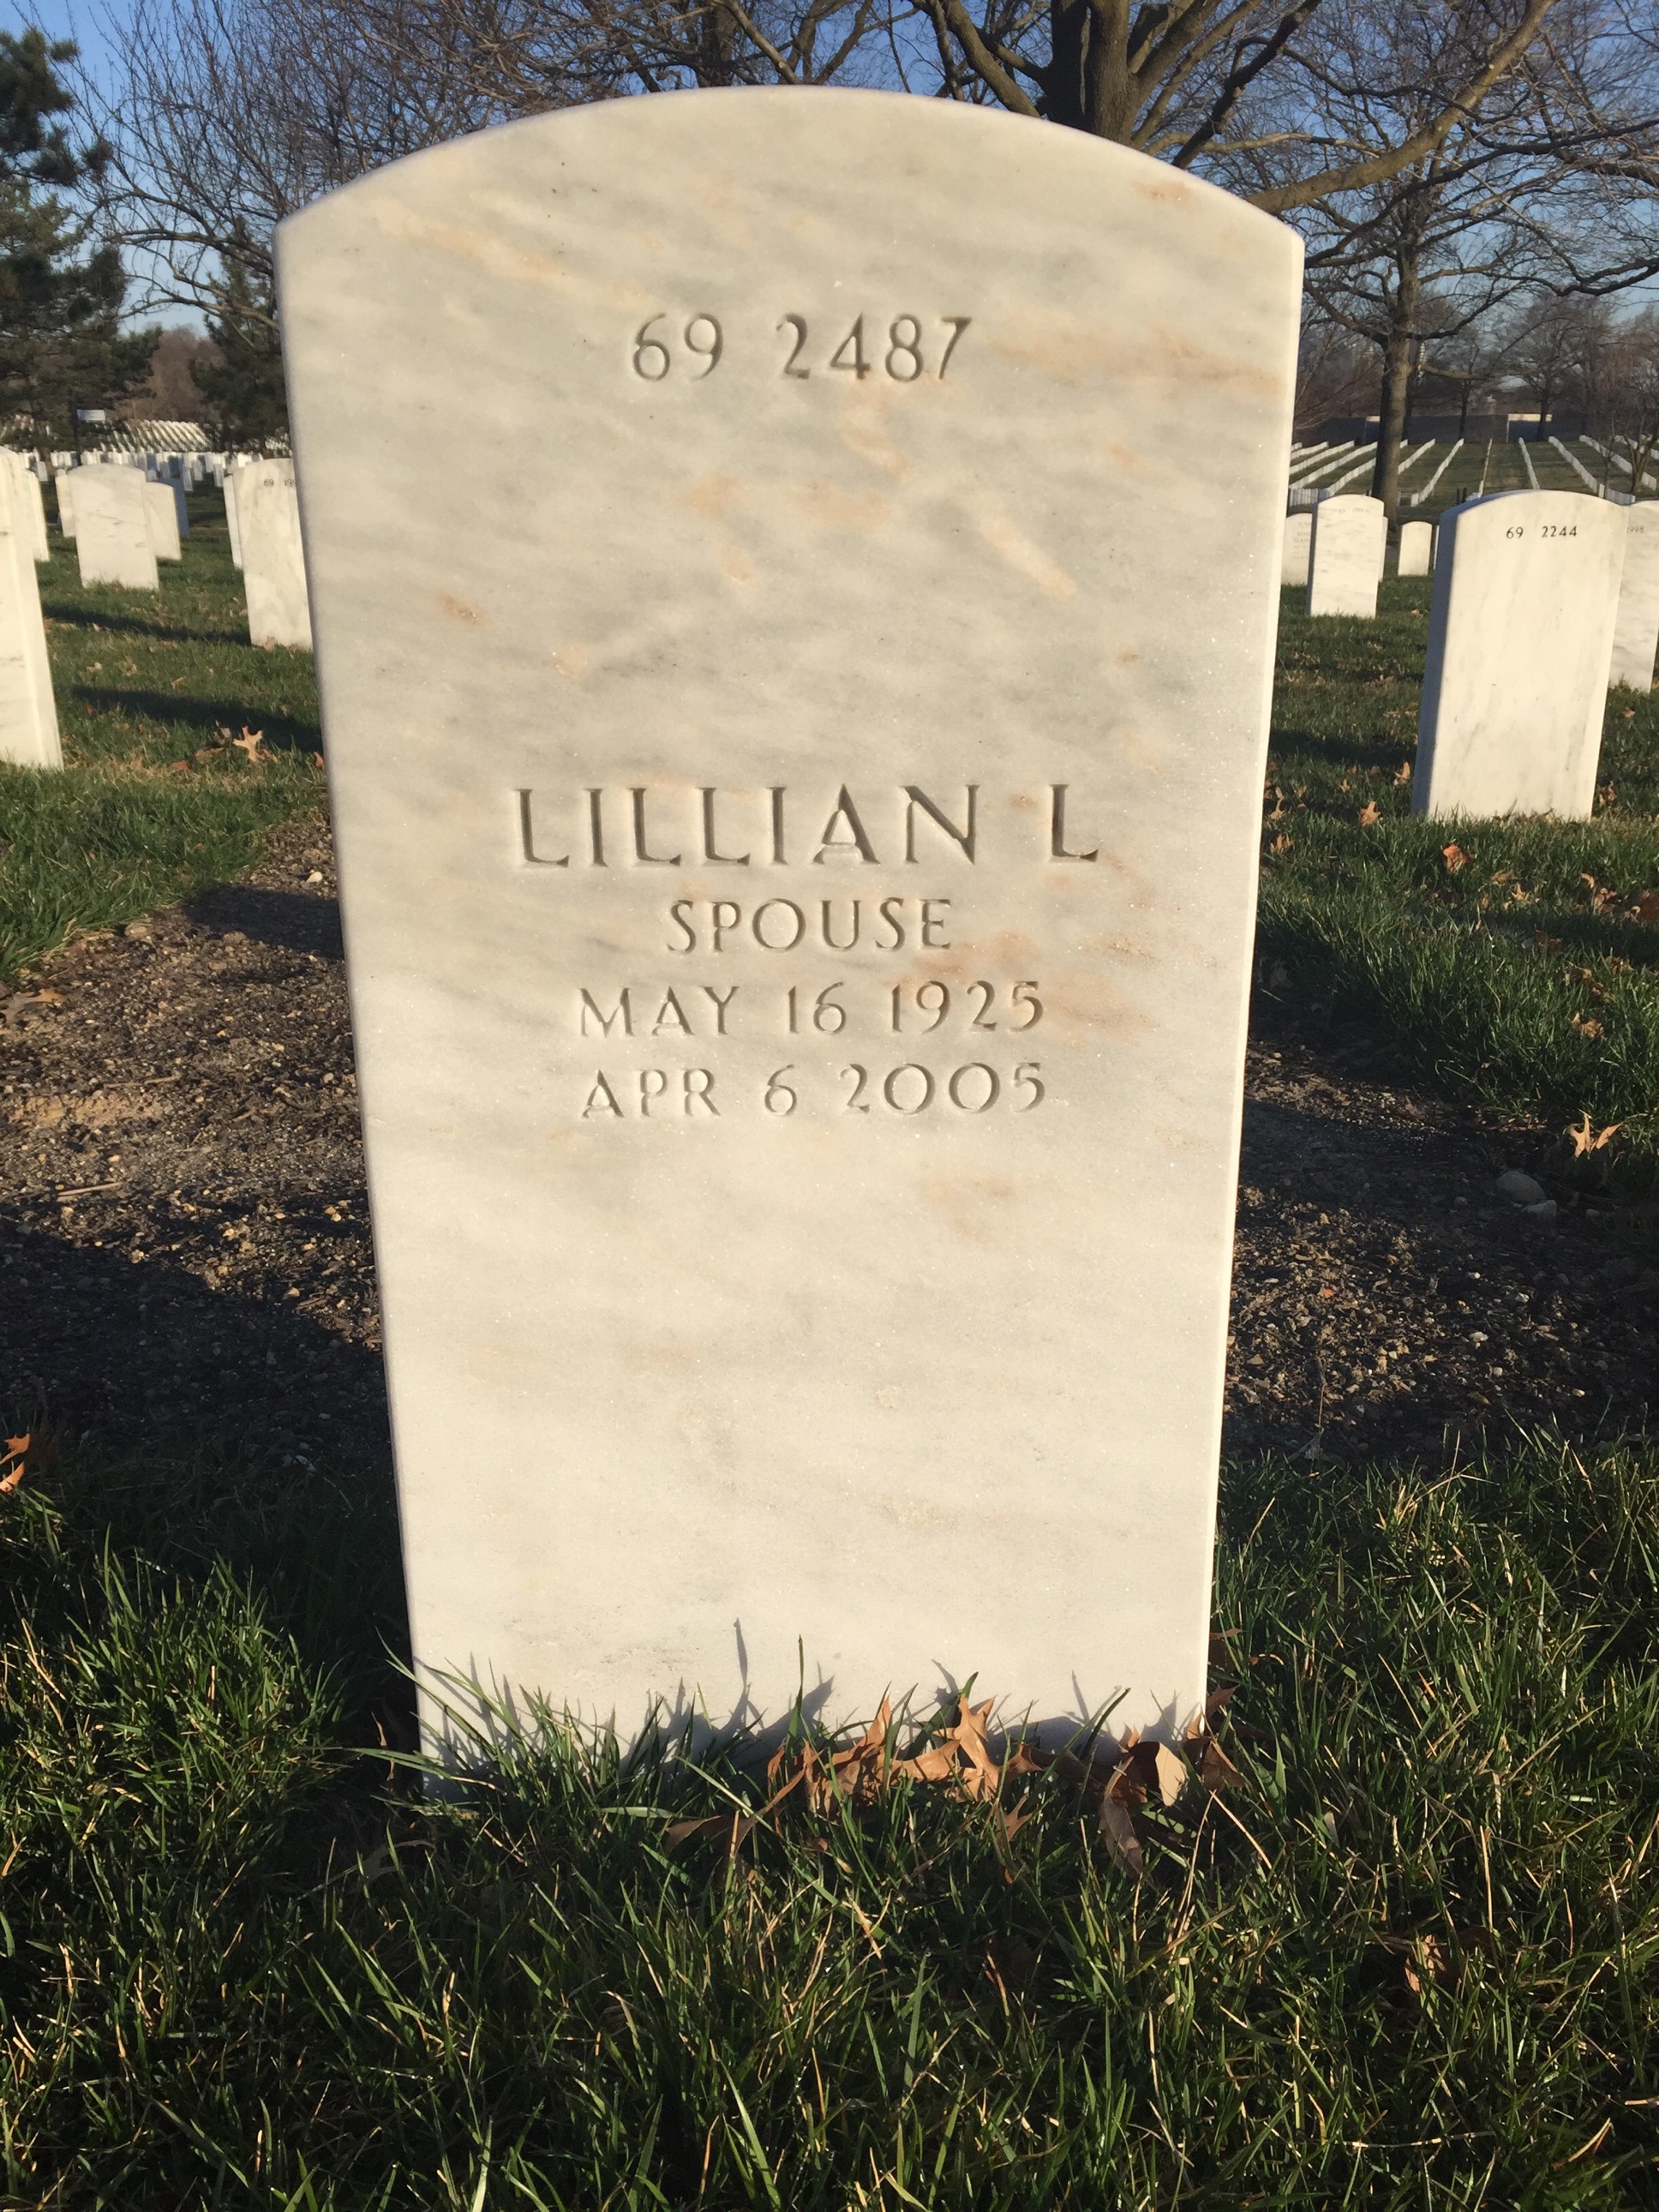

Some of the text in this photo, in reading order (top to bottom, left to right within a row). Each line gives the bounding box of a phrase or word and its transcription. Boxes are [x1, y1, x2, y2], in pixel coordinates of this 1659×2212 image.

[632, 311, 973, 382] 69 2487
[263, 478, 274, 487] 69
[1506, 525, 1578, 539] 69 2244
[513, 783, 1099, 868] LILLIAN L
[666, 898, 952, 954] SPOUSE
[578, 980, 1045, 1038] MAY 16 1925
[582, 1062, 1047, 1119] APR 6 2005
